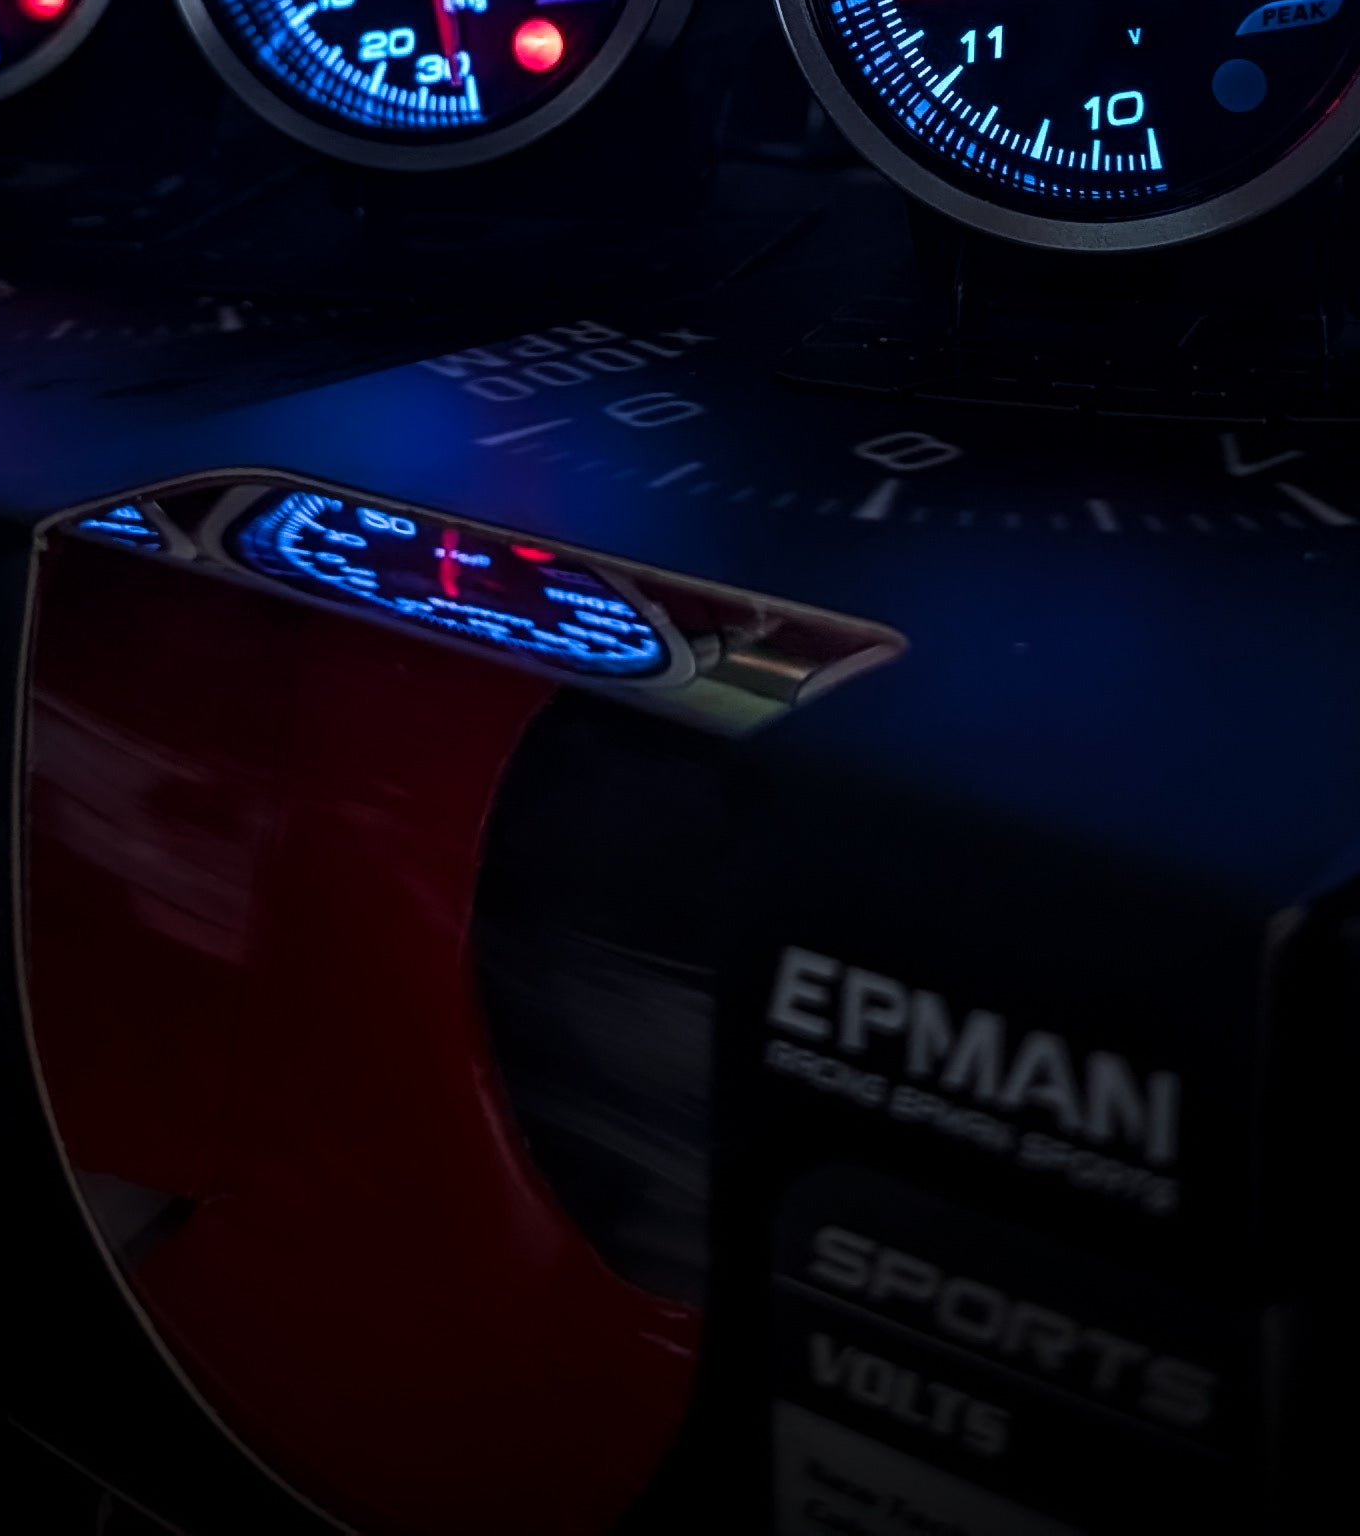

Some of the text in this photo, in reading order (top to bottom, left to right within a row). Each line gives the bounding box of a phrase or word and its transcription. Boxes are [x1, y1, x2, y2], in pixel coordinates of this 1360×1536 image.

[1261, 0, 1325, 26] PEAK
[358, 27, 416, 64] 20
[960, 25, 1003, 63] 11
[1084, 91, 1144, 130] 10
[766, 944, 1182, 1169] EPMAN
[807, 1224, 1222, 1430] SPORTS
[807, 1331, 1012, 1460] VOLTS
